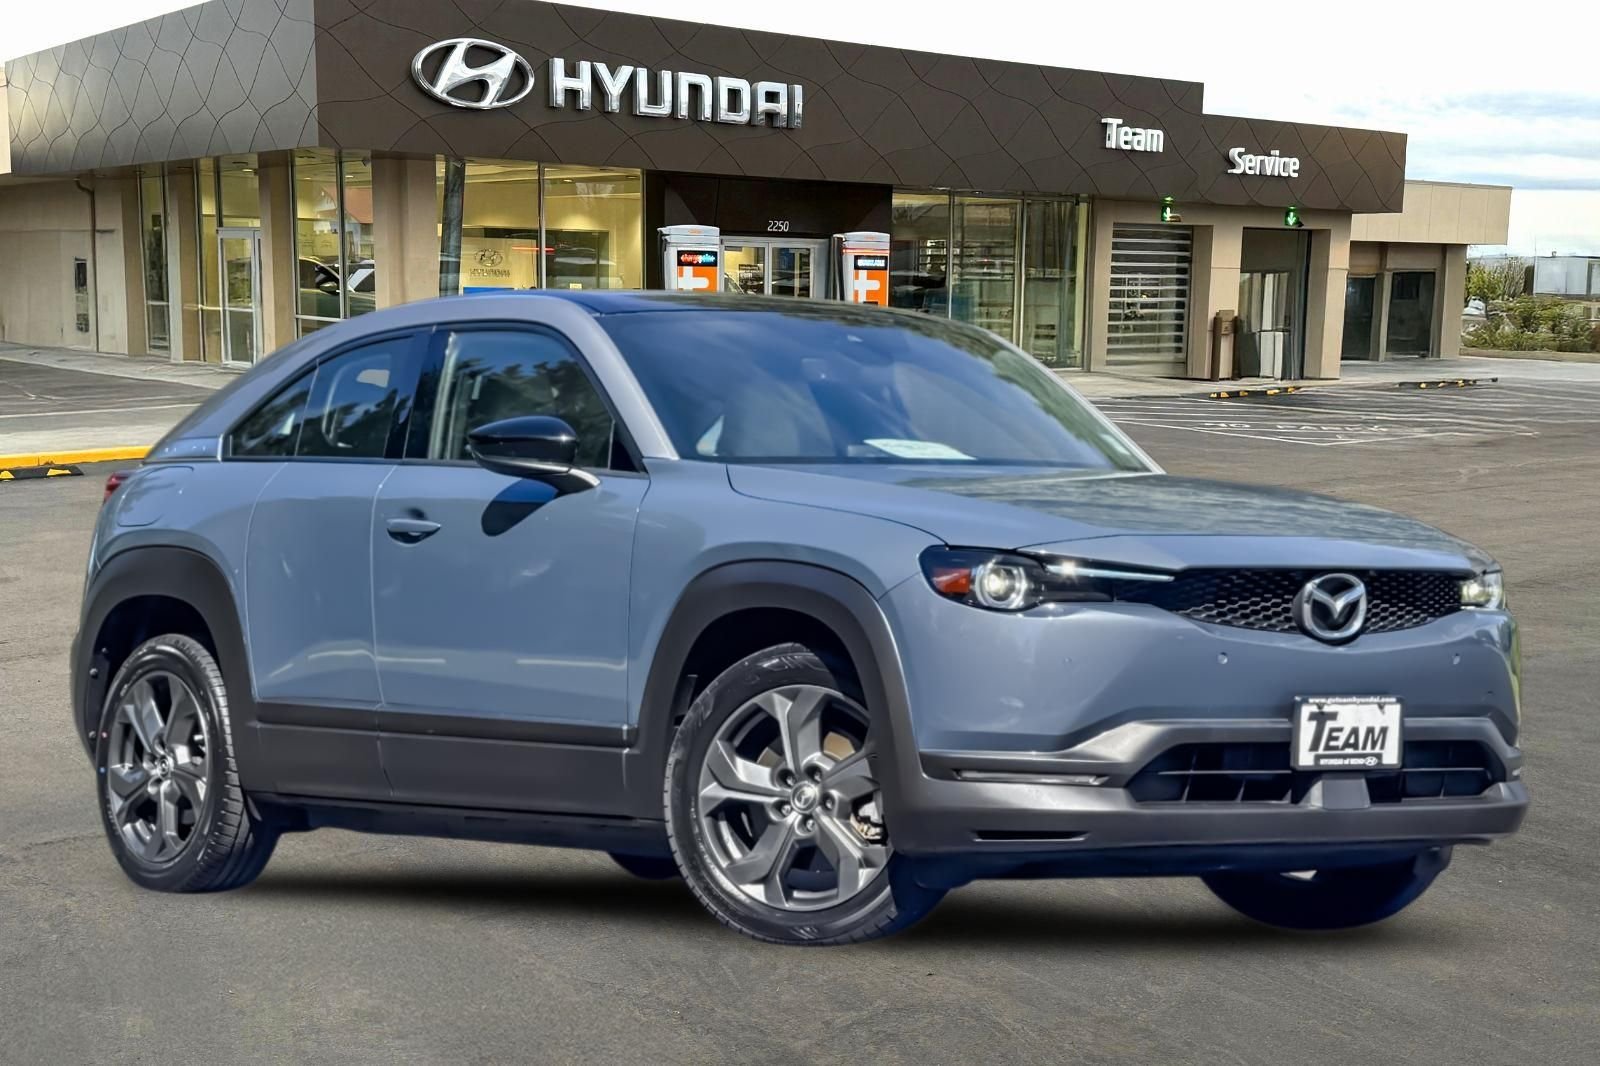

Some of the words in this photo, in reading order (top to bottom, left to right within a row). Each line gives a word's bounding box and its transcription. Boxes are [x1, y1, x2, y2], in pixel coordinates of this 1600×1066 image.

[549, 57, 803, 129] HYUNDAI
[1101, 117, 1164, 153] Team
[1227, 147, 1300, 178] Service
[767, 220, 790, 232] 2250
[1307, 711, 1389, 752] TEAM
